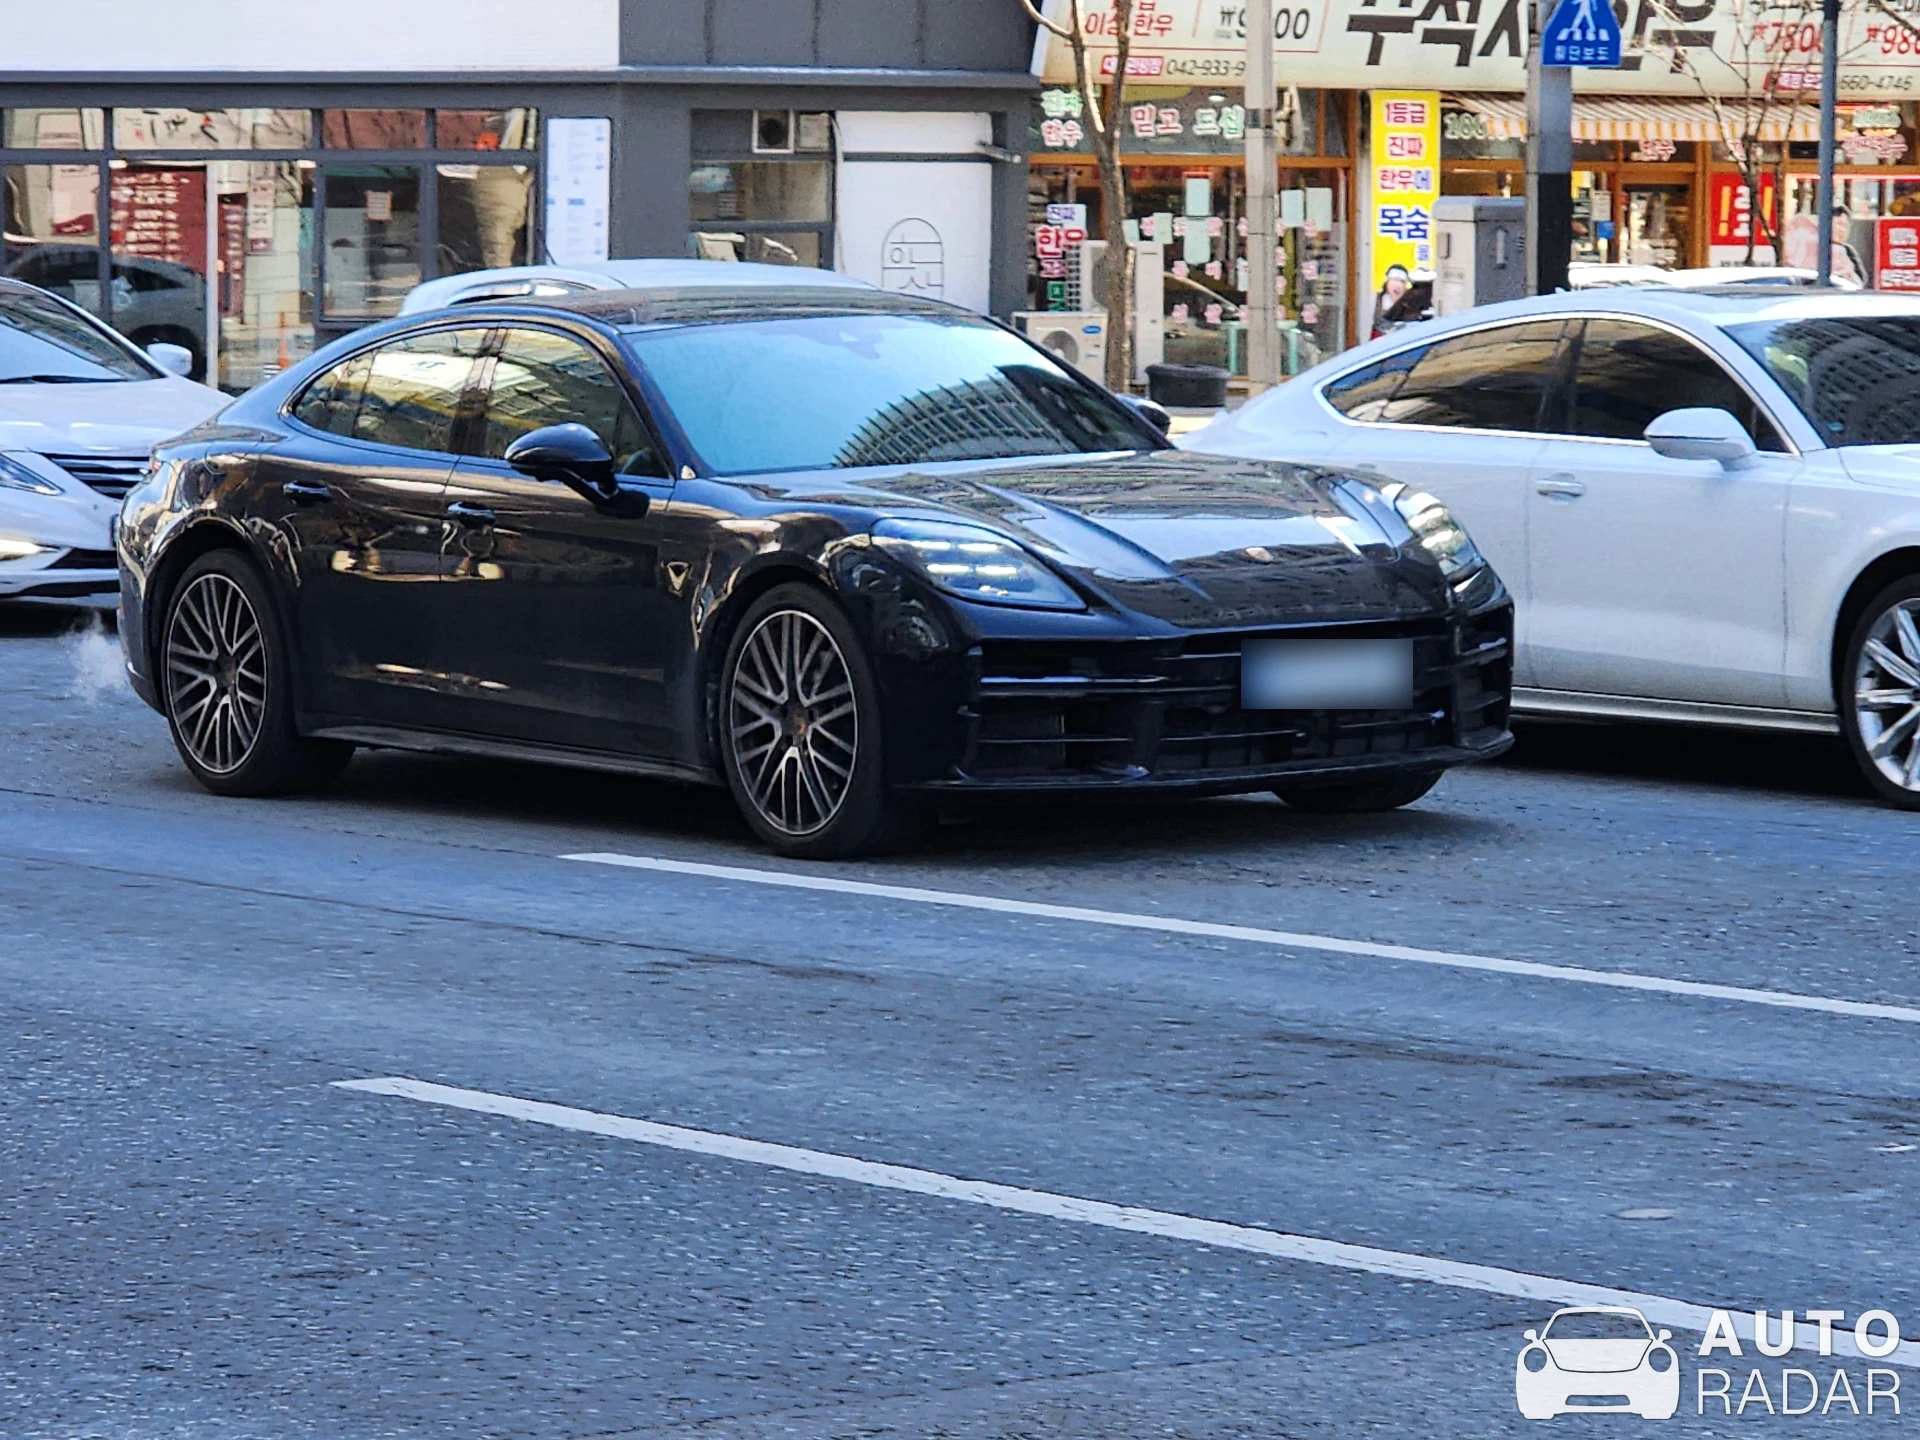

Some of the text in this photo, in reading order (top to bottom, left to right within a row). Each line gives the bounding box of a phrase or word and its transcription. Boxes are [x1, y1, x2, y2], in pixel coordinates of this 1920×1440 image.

[1134, 14, 1173, 36] 한우
[1166, 59, 1246, 76] 042-933-9
[1131, 103, 1183, 137] 믿고
[1385, 102, 1424, 124] 1등급
[1379, 207, 1429, 239] 목숨
